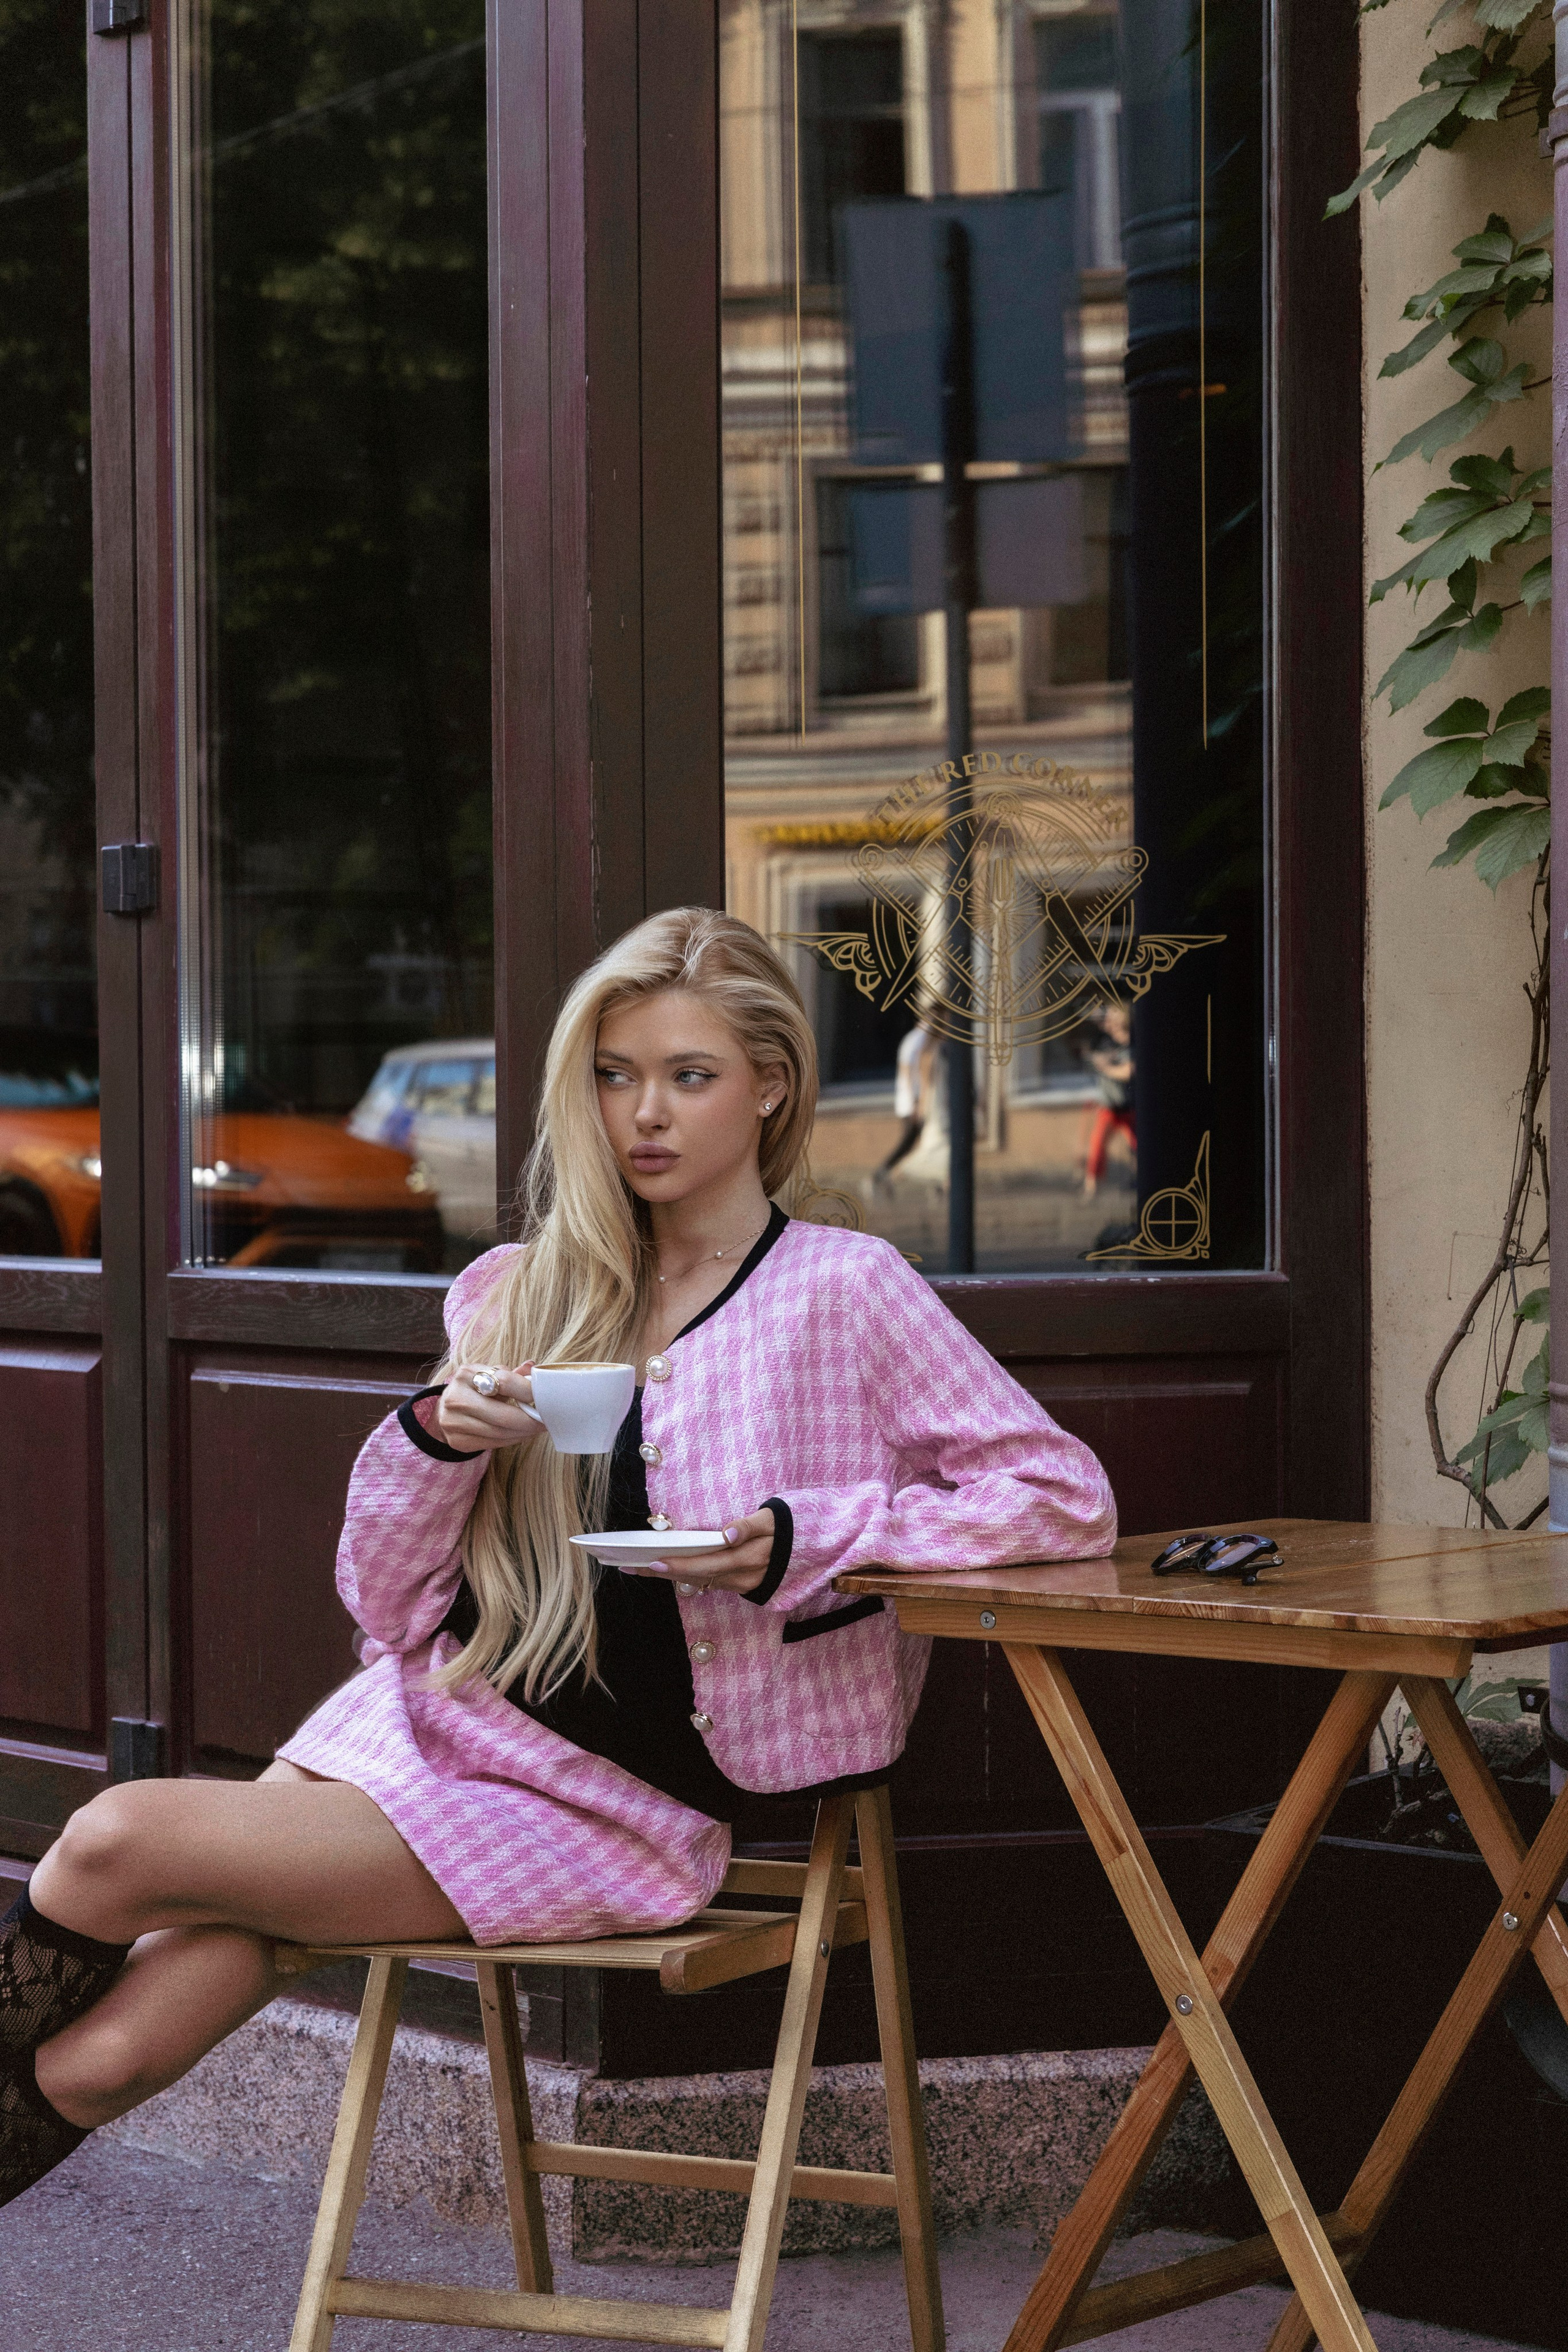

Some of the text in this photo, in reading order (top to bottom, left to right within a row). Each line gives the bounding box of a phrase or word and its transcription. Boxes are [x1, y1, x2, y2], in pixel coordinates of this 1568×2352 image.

[876, 752, 1129, 831] THE RED CORNER
